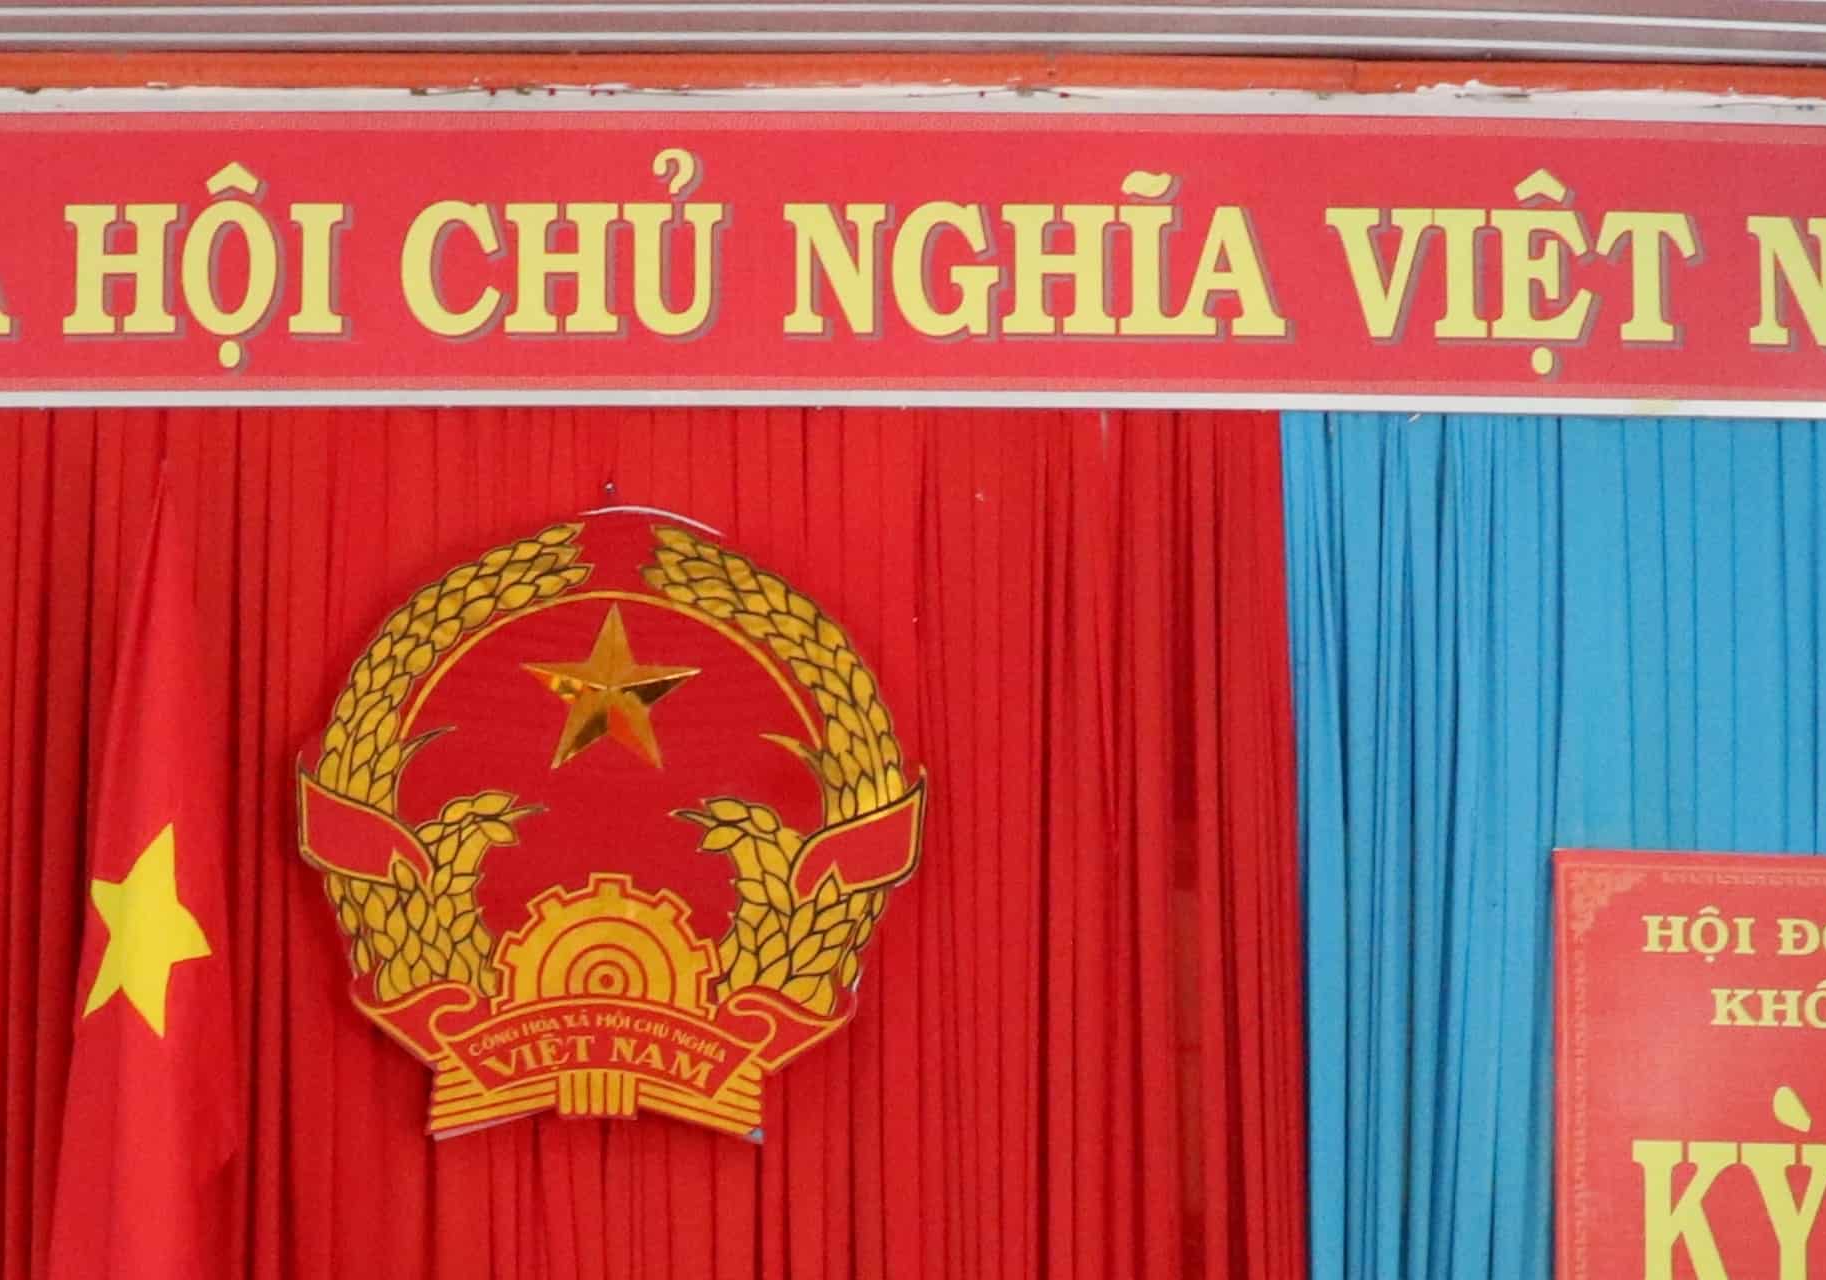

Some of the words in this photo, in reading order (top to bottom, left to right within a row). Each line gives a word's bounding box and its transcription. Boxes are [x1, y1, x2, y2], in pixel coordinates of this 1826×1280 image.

[61, 161, 345, 369] HỘI
[400, 147, 724, 337] CHỦ
[782, 169, 1287, 338] NGHĨA
[1324, 167, 1697, 376] VIỆT
[1641, 904, 1757, 964] HỘI
[479, 1034, 595, 1077] VIỆT
[608, 1035, 714, 1089] NAM
